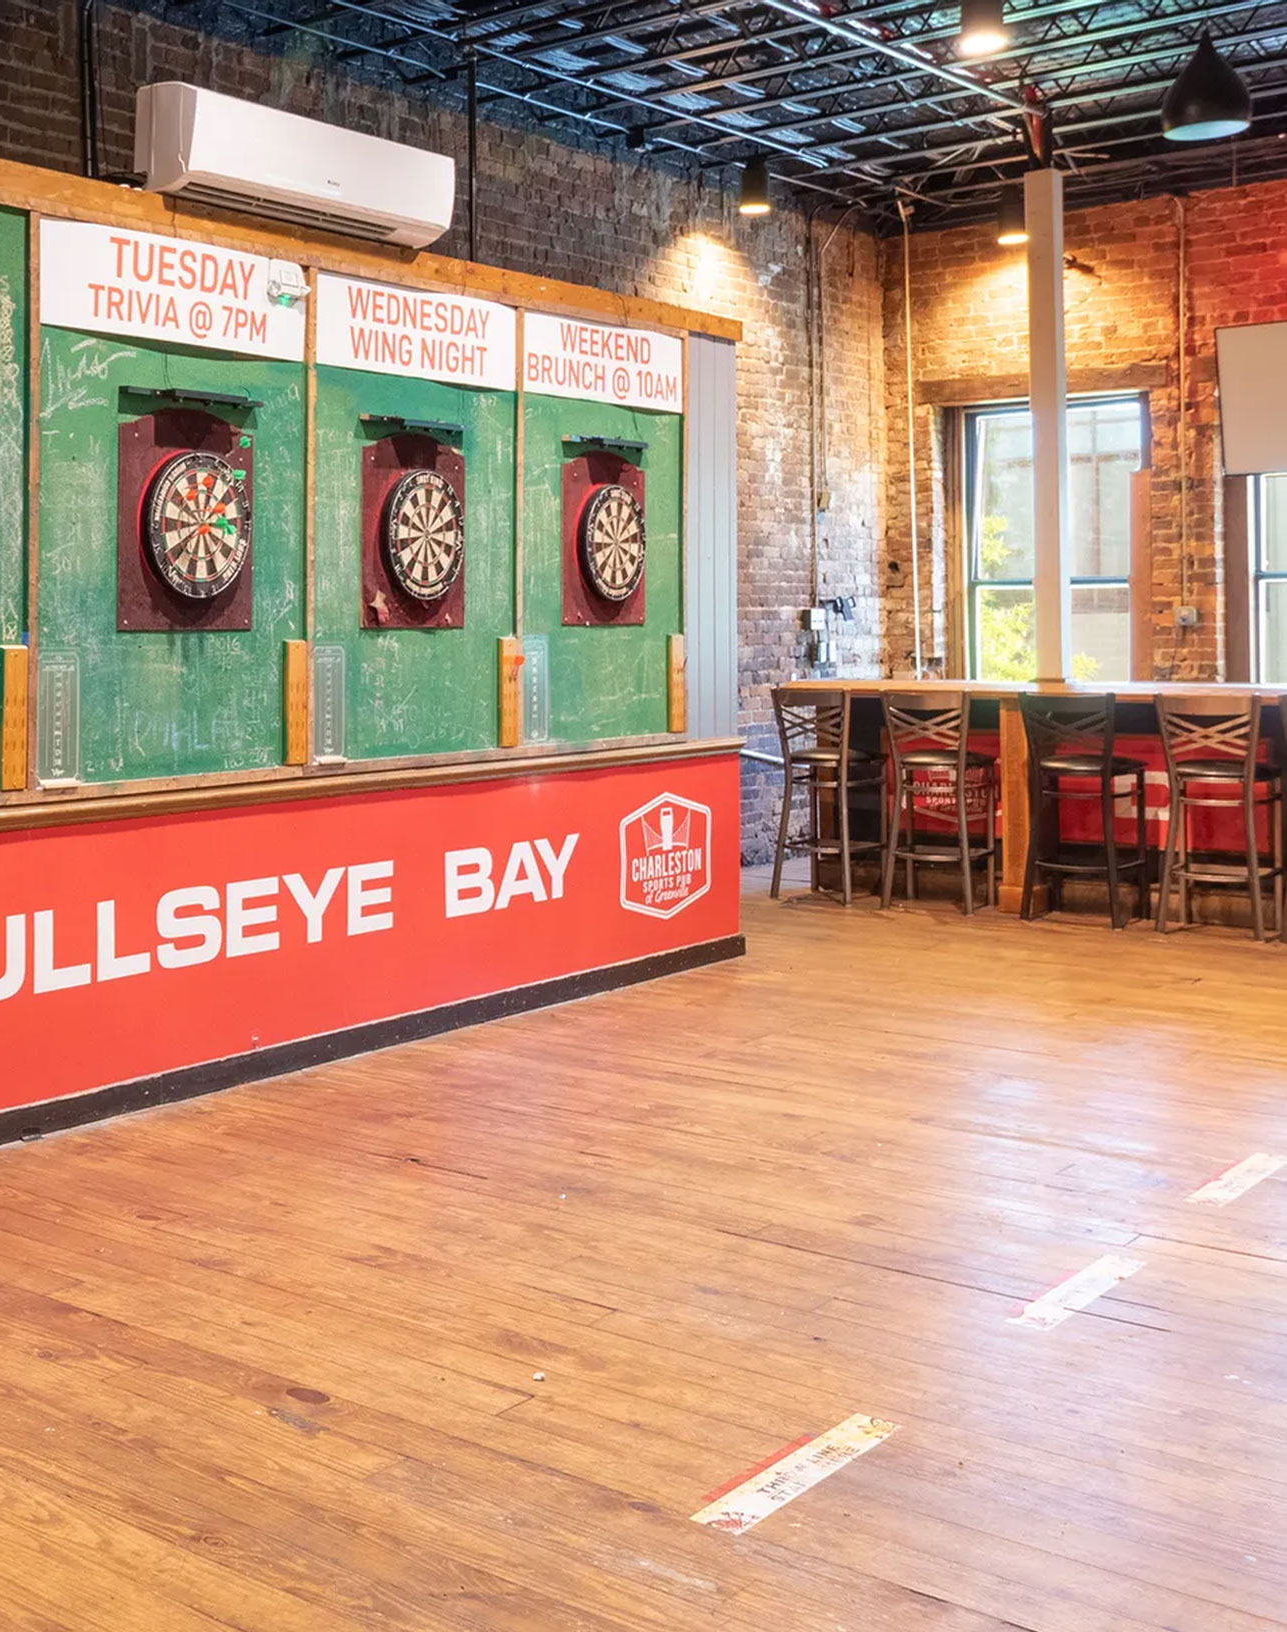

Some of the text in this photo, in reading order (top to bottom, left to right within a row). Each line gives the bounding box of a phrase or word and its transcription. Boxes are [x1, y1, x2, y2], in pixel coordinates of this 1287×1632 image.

[109, 236, 256, 301] TUESDAY
[87, 283, 268, 344] TRIVIA @ 7PM
[347, 285, 490, 340] WEDNESDAY
[349, 325, 488, 377] WING NIGHT
[560, 322, 652, 365] WEEKEND
[527, 352, 678, 403] BRUNCH @ 10AM
[444, 833, 580, 919] BAY
[631, 847, 702, 883] CHARLESTON
[642, 873, 692, 894] SPORTS PUB
